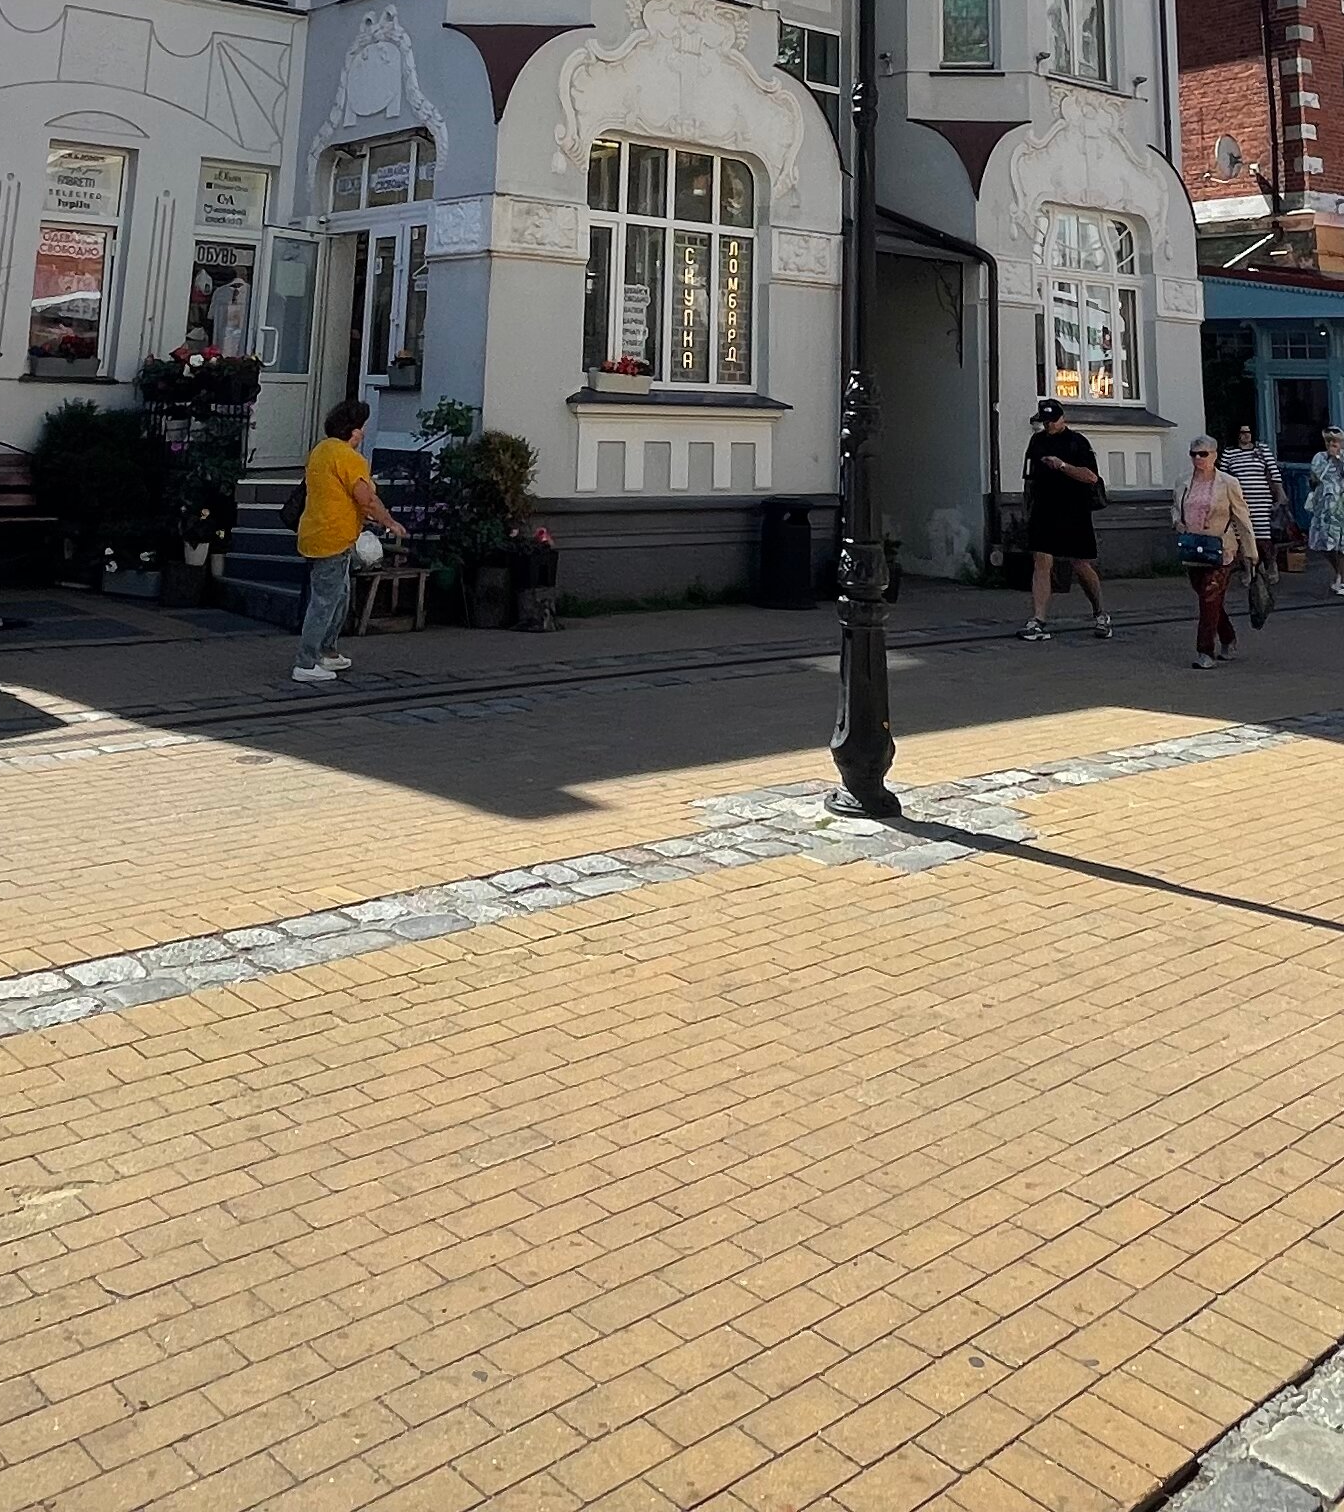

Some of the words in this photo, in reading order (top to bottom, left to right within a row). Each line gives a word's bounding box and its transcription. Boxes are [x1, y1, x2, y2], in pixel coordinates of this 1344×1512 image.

[49, 189, 102, 200] SELECTED
[40, 243, 99, 256] СВОБОДНО
[197, 246, 238, 265] ОБУВЬ
[682, 247, 695, 369] СКУПКА
[725, 241, 739, 363] ЛОМБАРД
